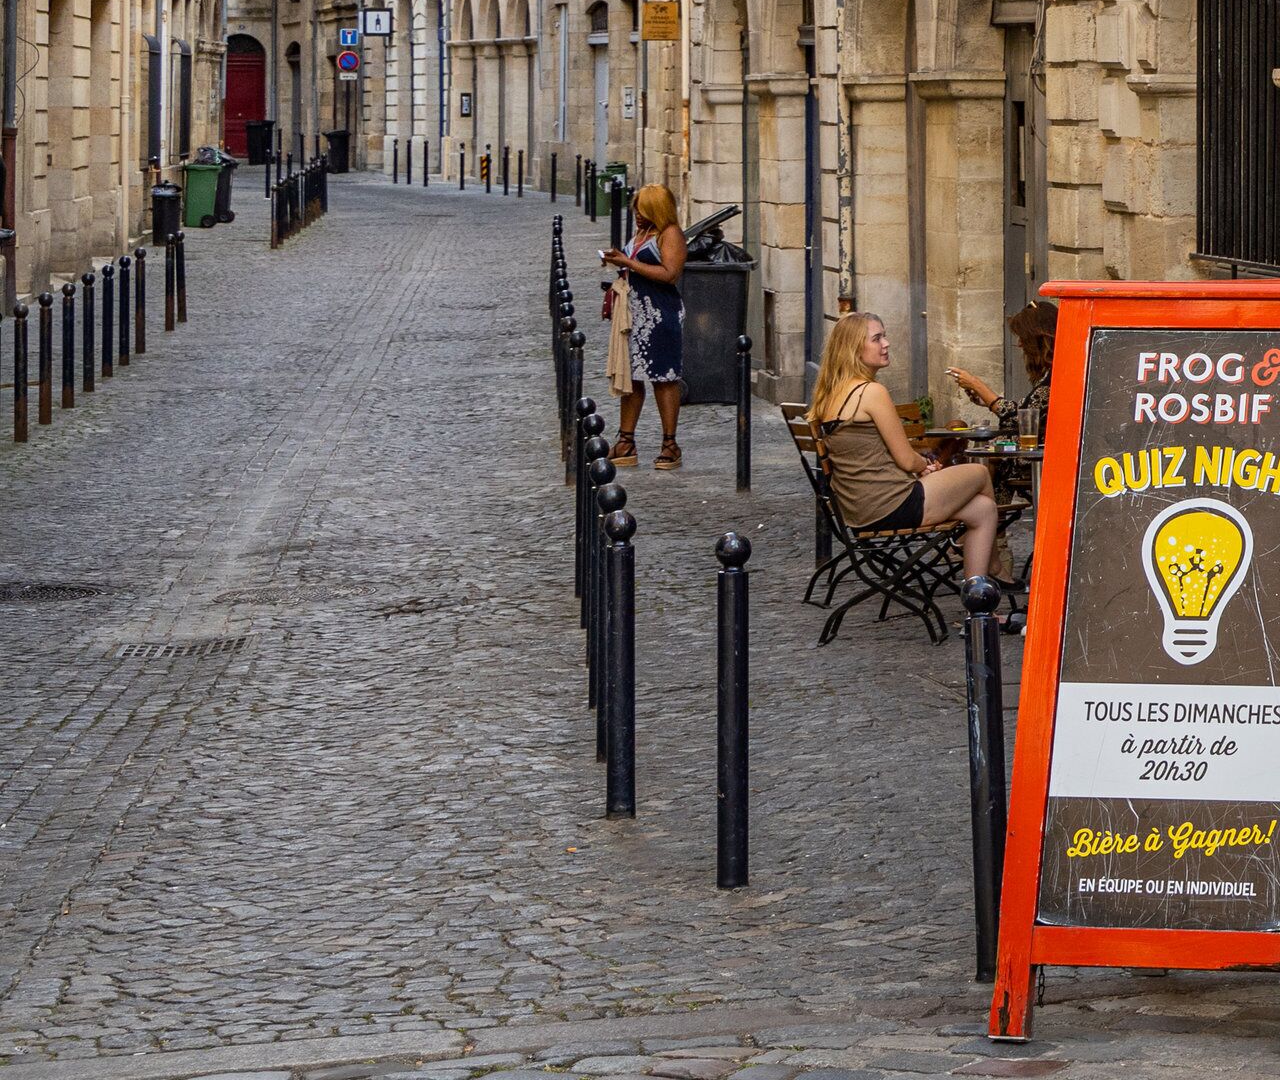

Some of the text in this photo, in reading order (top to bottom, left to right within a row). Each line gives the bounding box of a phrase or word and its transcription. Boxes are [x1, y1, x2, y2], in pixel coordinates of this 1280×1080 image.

[1136, 352, 1245, 384] FROG
[1134, 392, 1274, 424] ROSBIF
[1094, 446, 1186, 497] QUIZ
[1084, 701, 1132, 722] TOUS
[1137, 702, 1170, 723] LES
[1121, 733, 1239, 759] à partir de
[1139, 760, 1208, 782] 20h30
[1066, 819, 1278, 859] Bière à Gagner!
[1078, 875, 1257, 897] EN ÉQUIPE OU EN INDIVIDUEL
